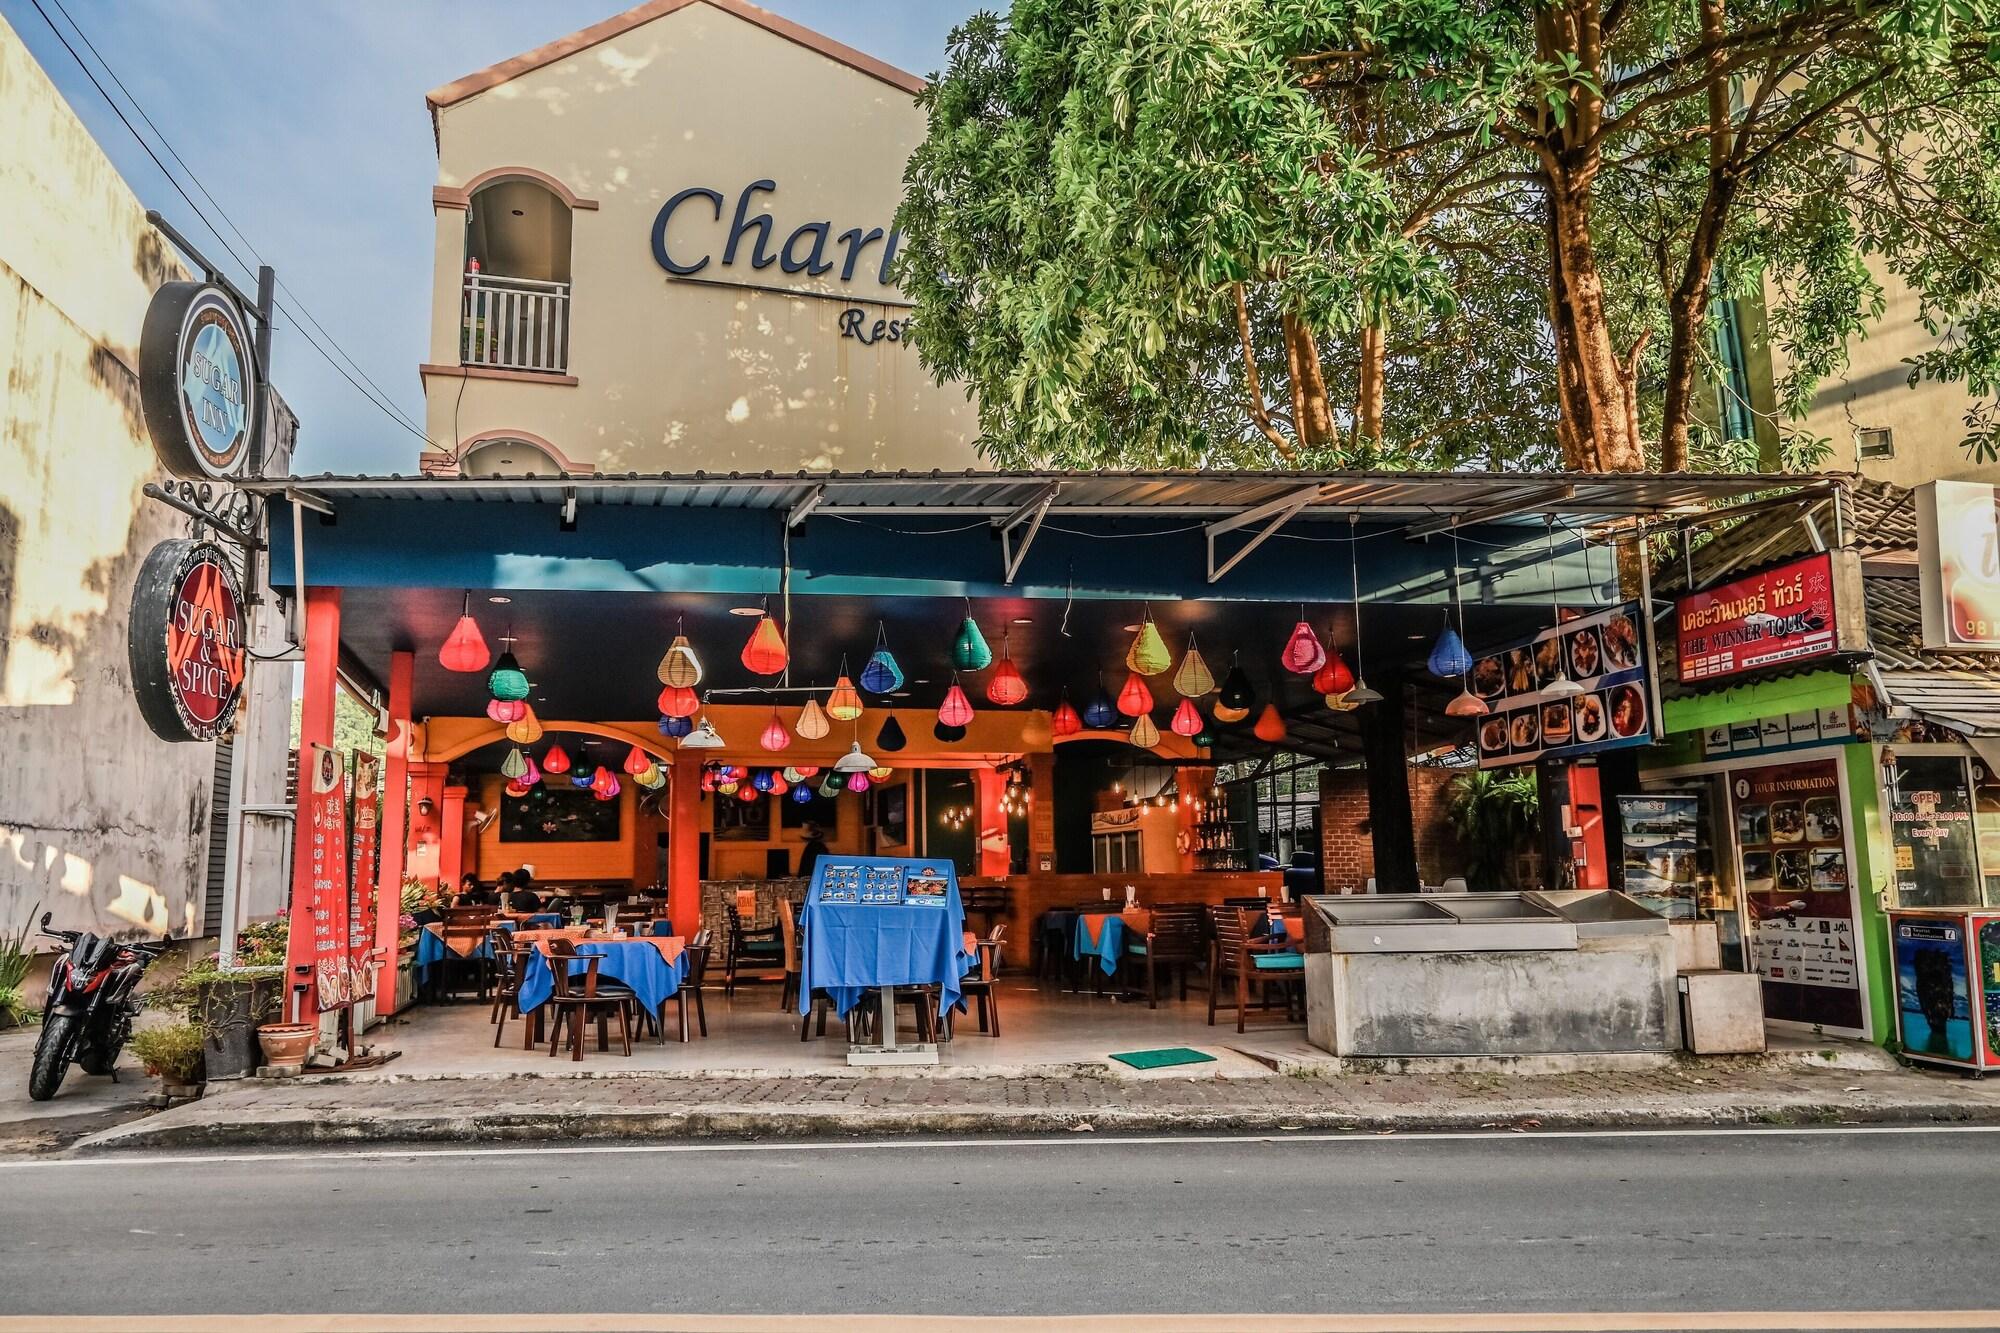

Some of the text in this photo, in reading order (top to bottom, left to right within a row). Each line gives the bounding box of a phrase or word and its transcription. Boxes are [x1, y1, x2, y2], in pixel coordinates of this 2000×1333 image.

[651, 179, 904, 286] Charl
[838, 308, 914, 346] Rest
[193, 351, 239, 407] SUGAR
[202, 397, 228, 437] INN
[1682, 572, 1803, 632] เดอะวินเนอร์ ทัวร์
[179, 600, 236, 649] SUGAR
[1681, 636, 1709, 657] THE
[1712, 623, 1764, 651] WINNER
[1766, 613, 1808, 638] TOUR
[1966, 620, 1986, 635] 98
[200, 632, 213, 665] &
[182, 659, 228, 700] SPICE
[202, 724, 216, 738] Thai
[216, 699, 237, 733] Cuisine
[1822, 722, 1847, 731] Emirates
[1753, 776, 1836, 793] TOUR INFORMATION
[1911, 792, 1941, 804] OPEN
[1892, 812, 1915, 821] 10:00
[1911, 827, 1949, 839] Every day
